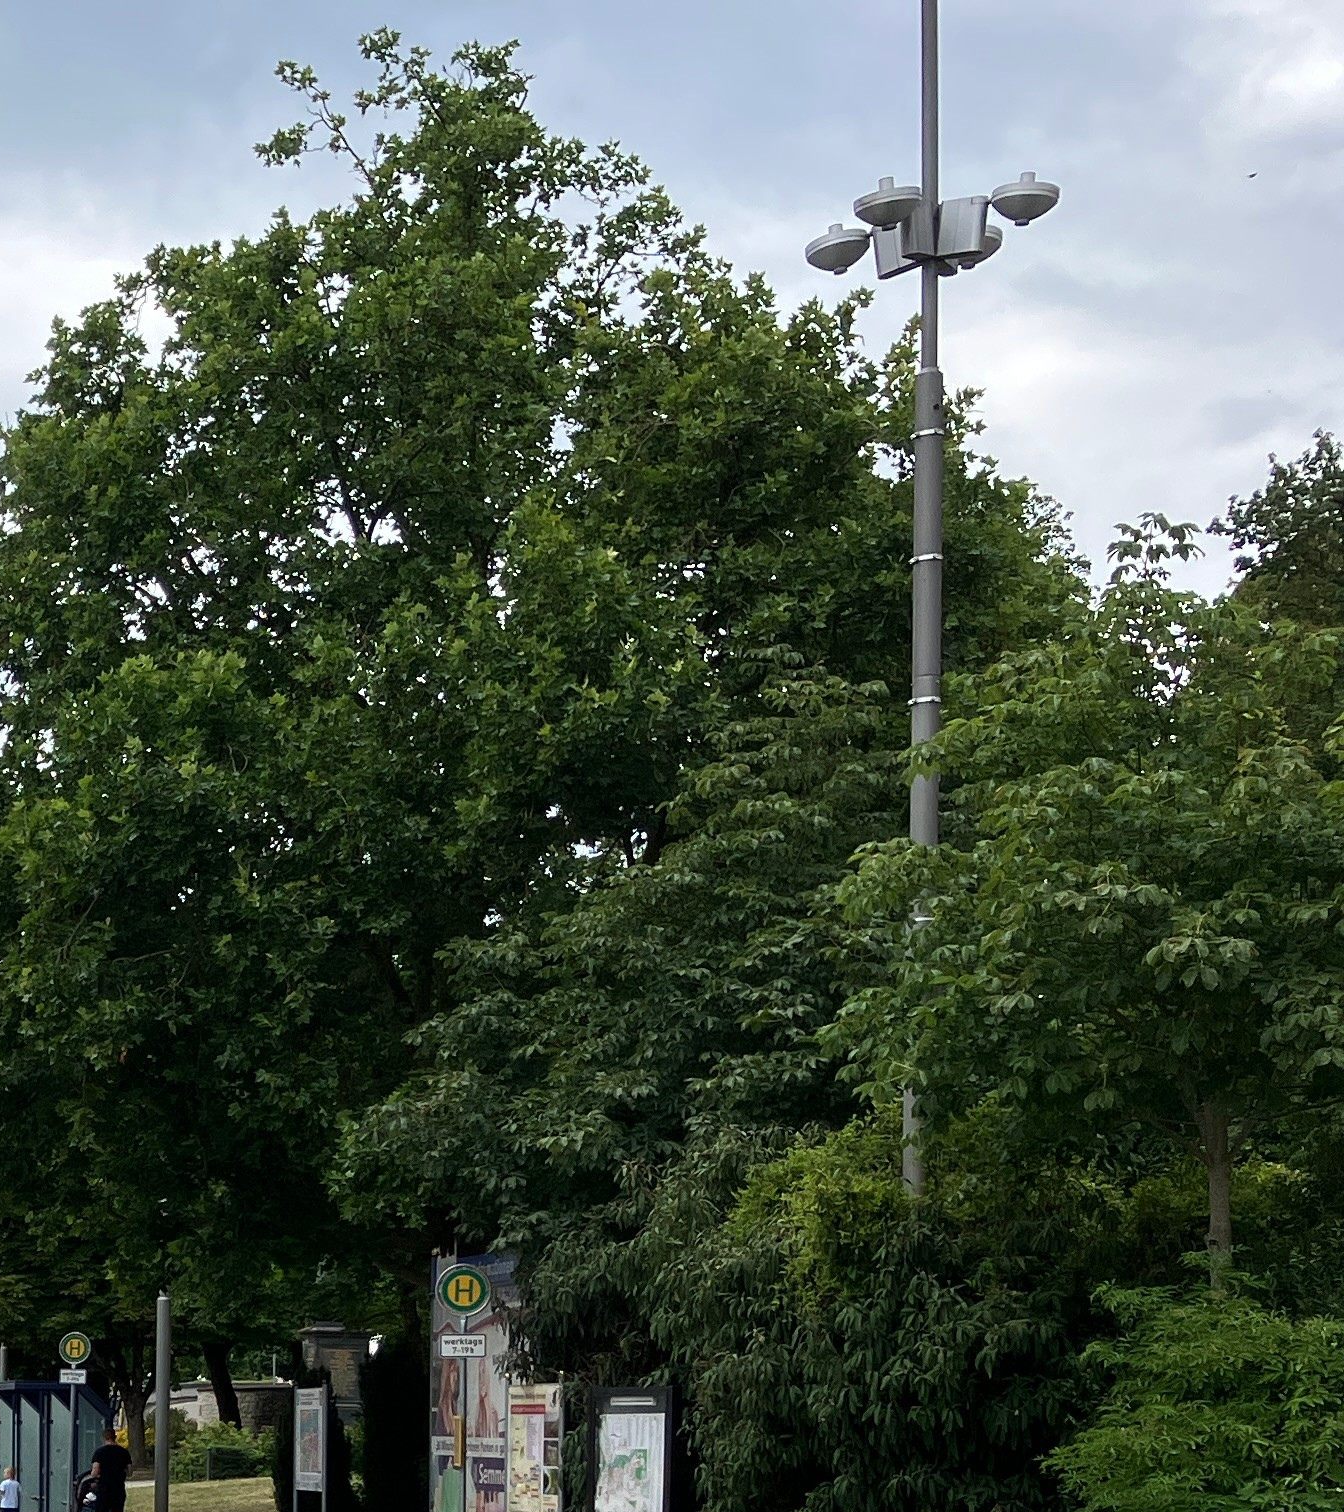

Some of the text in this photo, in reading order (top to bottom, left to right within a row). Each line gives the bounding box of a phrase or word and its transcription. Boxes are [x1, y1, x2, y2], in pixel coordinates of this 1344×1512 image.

[454, 1278, 474, 1303] H
[69, 1340, 81, 1356] H
[443, 1338, 483, 1347] werktags
